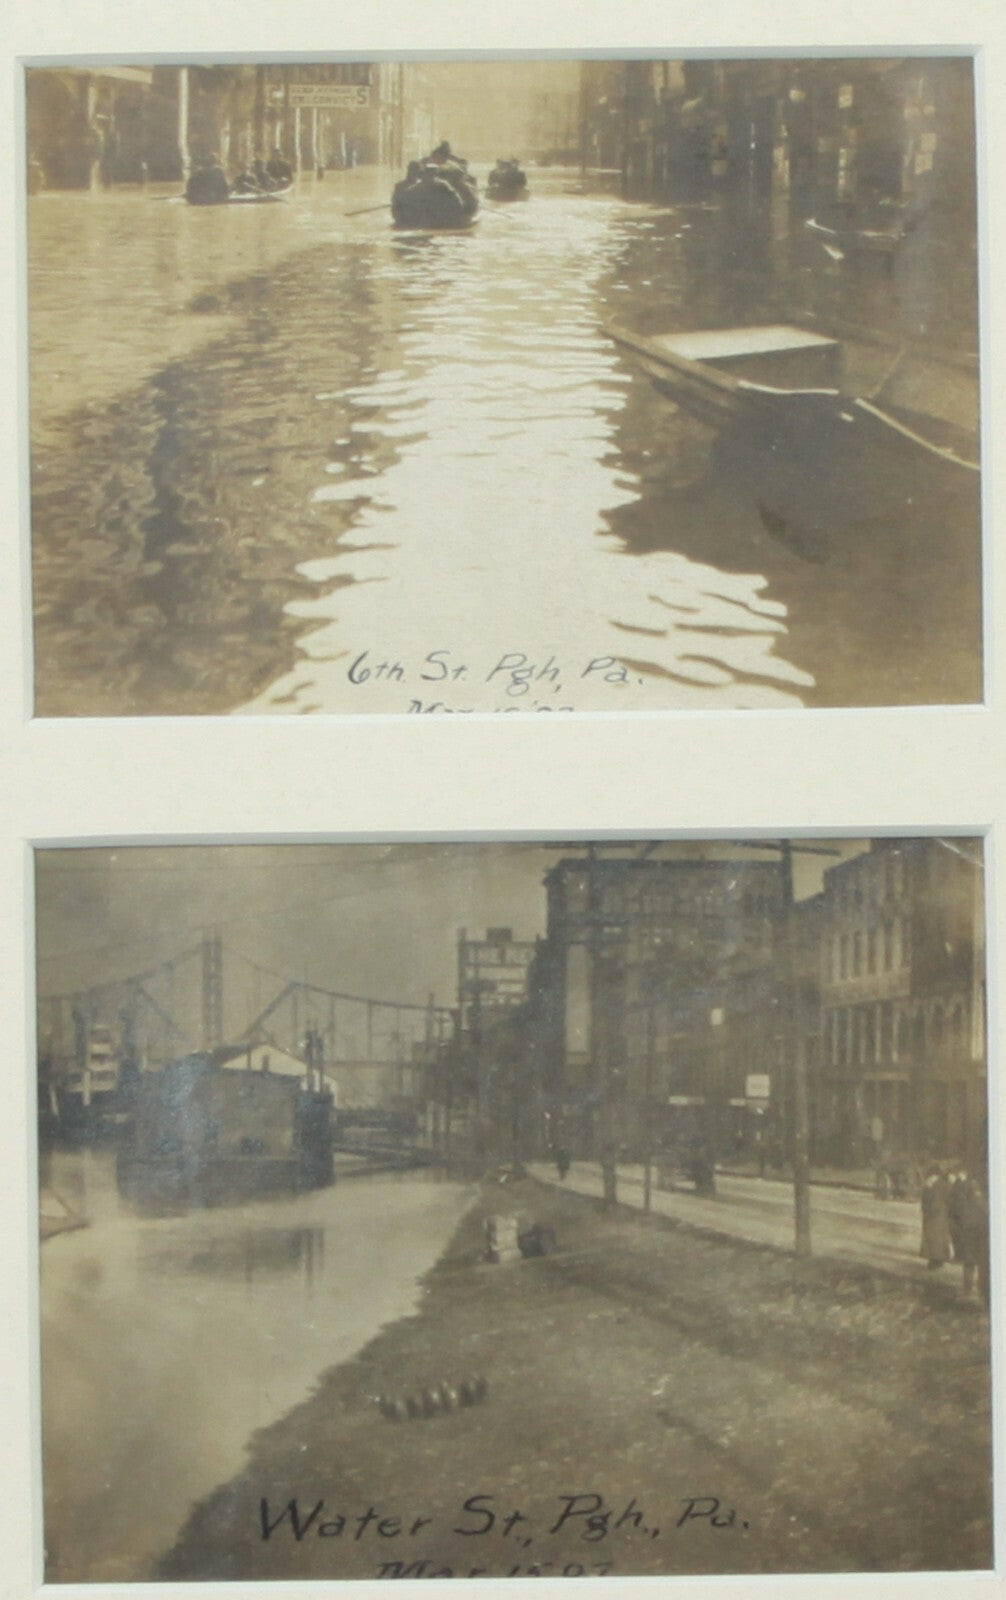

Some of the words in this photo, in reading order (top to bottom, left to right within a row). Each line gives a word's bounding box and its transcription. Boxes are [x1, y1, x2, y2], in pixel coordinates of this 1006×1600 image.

[580, 655, 643, 685] Pa.
[259, 1497, 433, 1541] Water
[676, 1497, 751, 1529] Pa.
